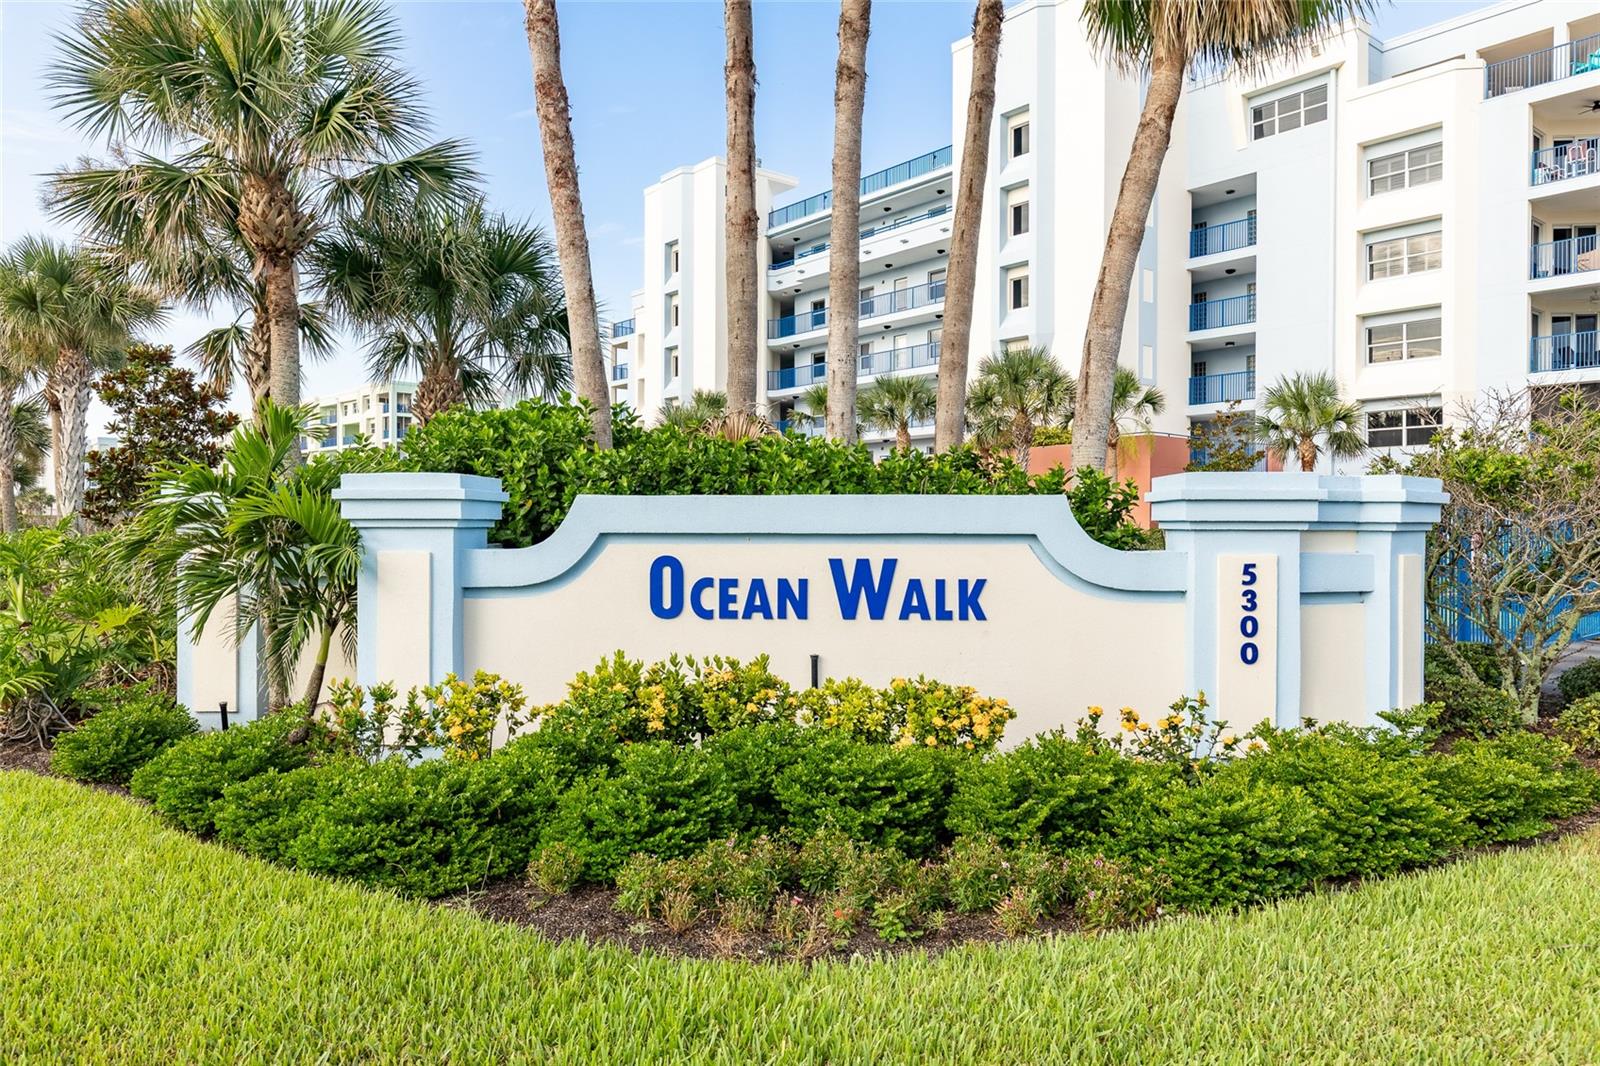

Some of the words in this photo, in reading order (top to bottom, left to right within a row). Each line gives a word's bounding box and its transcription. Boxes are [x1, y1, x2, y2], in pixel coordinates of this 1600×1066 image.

[649, 555, 809, 620] OCEAN
[828, 558, 987, 621] WALK
[1240, 563, 1259, 665] 5300
